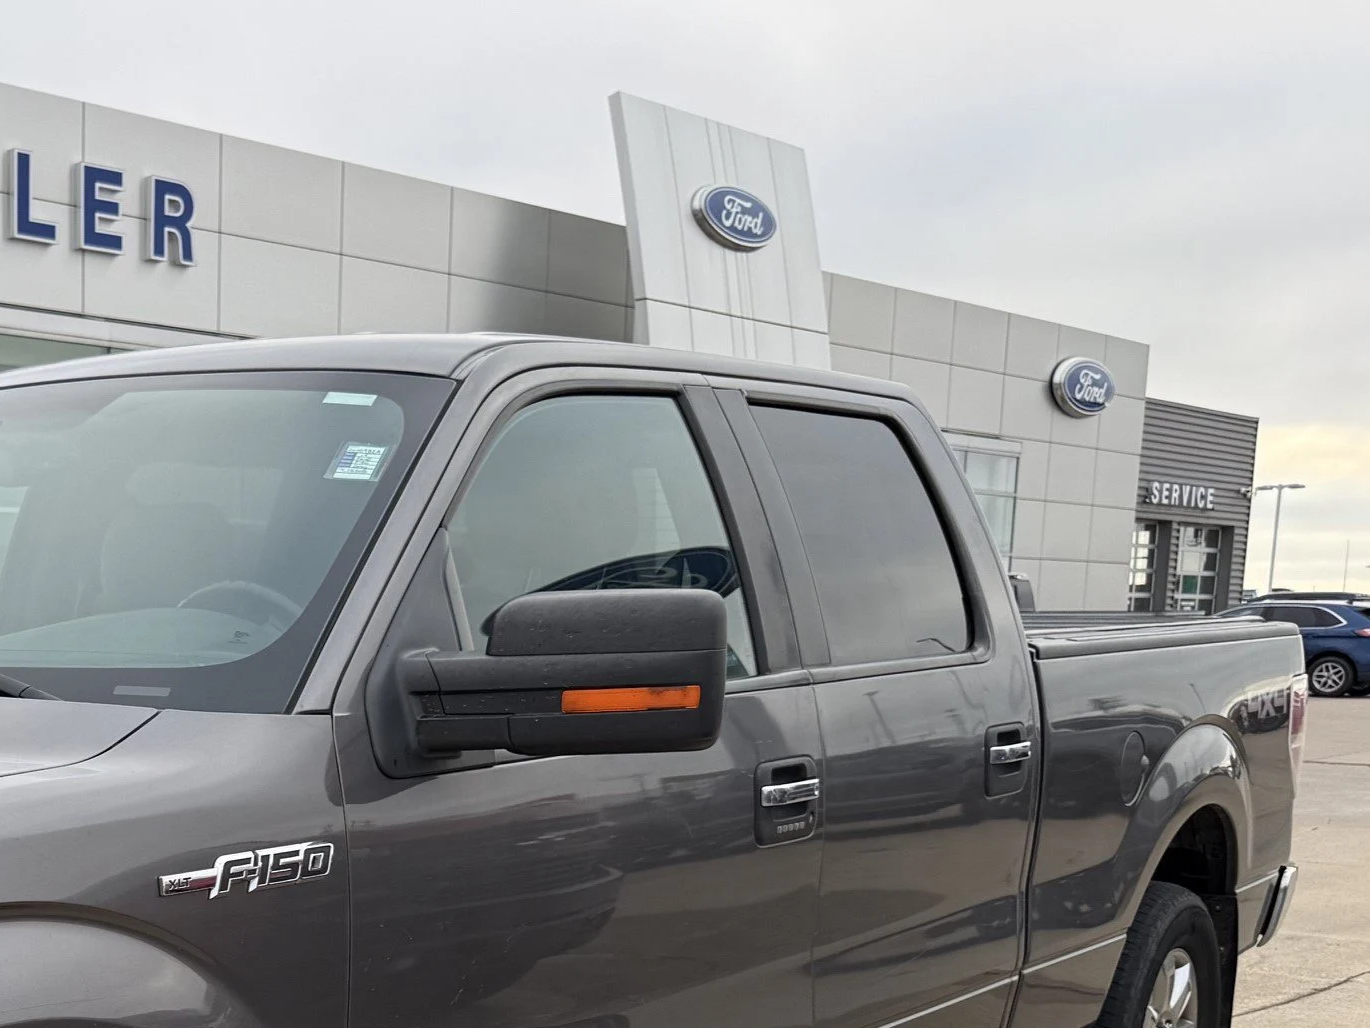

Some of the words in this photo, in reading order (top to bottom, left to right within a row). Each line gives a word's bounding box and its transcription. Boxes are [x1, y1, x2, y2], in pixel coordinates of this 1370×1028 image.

[721, 194, 765, 235] Ford
[1074, 368, 1109, 407] Ford
[1150, 480, 1215, 510] SERVICE
[167, 876, 192, 891] XLT
[208, 842, 334, 900] F-150
